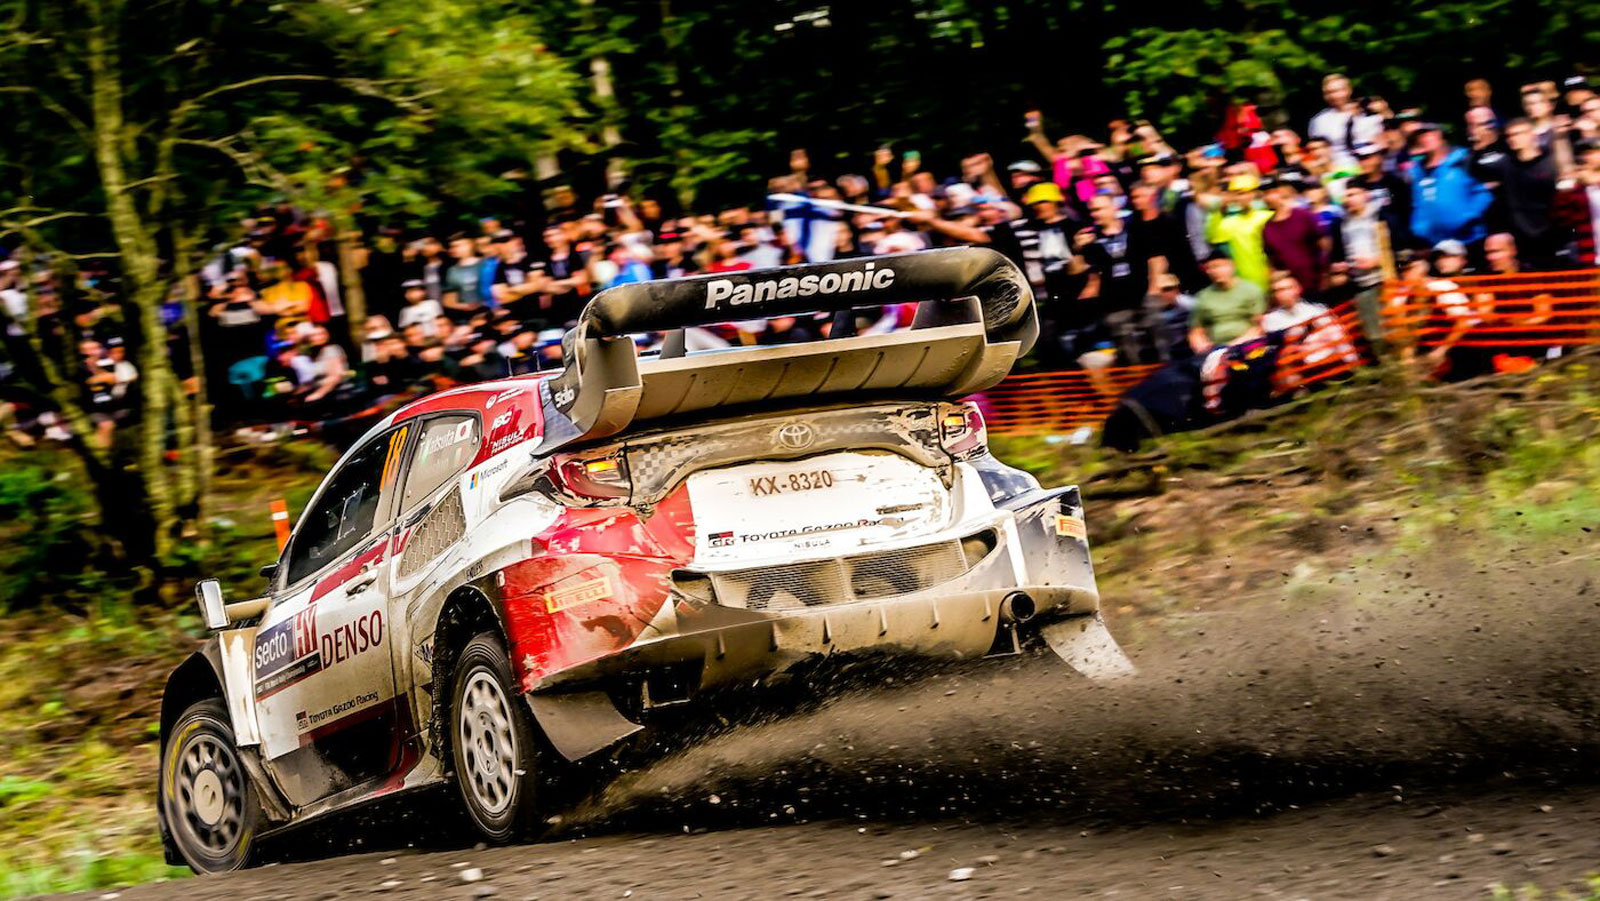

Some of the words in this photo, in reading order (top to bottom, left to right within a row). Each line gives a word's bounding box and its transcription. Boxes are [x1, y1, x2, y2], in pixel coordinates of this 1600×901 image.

[705, 262, 895, 309] Panasonic
[379, 426, 408, 492] 18
[751, 470, 833, 496] KX-8320
[739, 530, 798, 543] TOYOTA
[255, 631, 288, 669] secto
[321, 609, 383, 669] DENSO
[308, 709, 333, 724] TOYOTA
[333, 699, 356, 714] GAZOO
[356, 691, 379, 706] Racing
